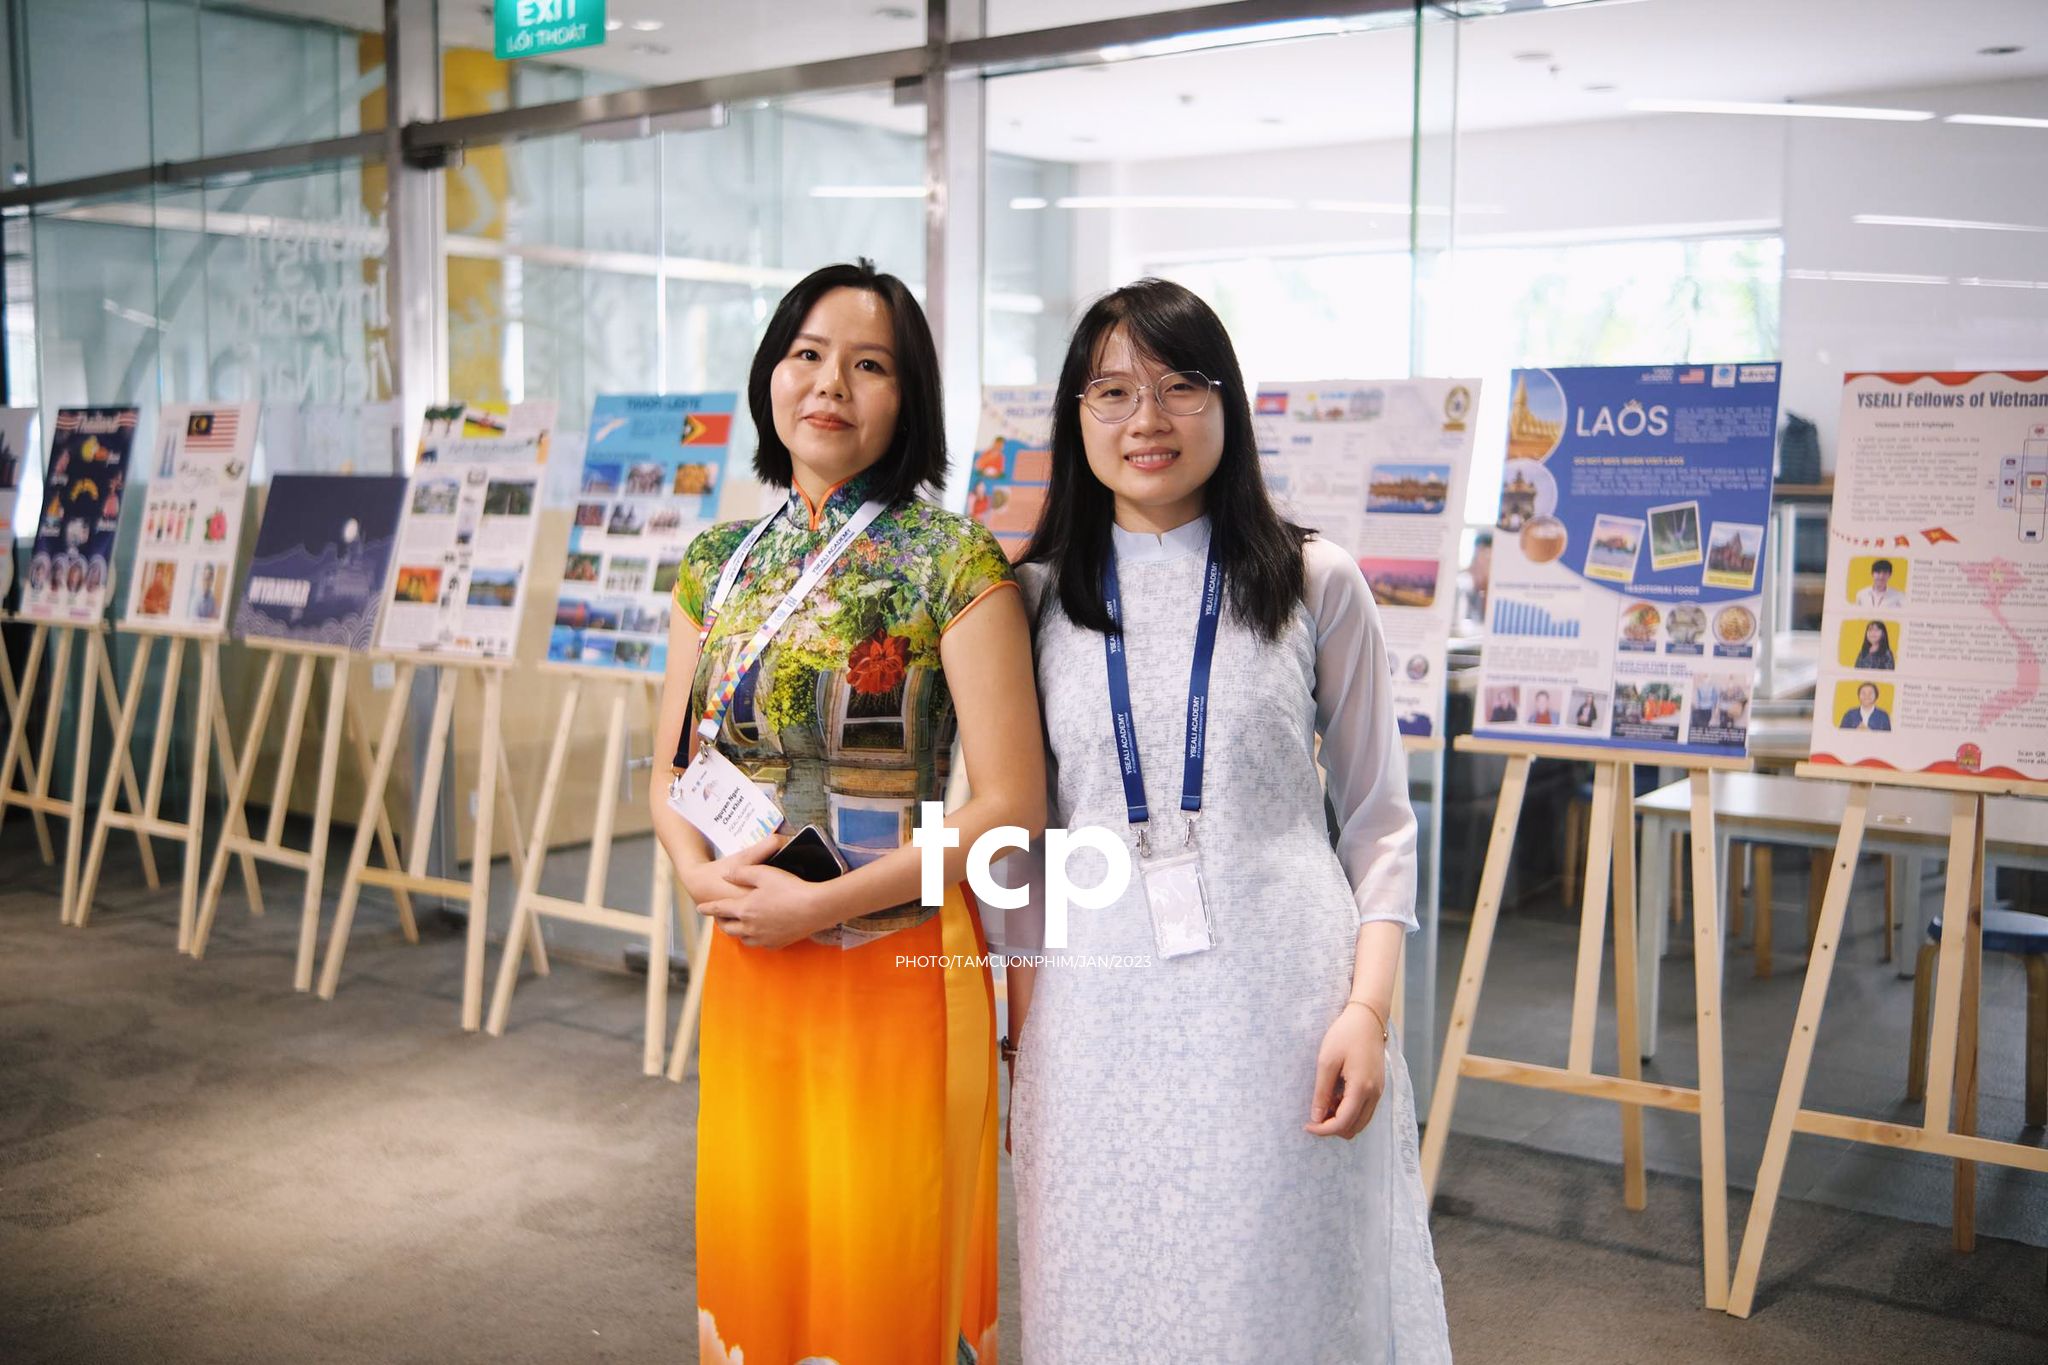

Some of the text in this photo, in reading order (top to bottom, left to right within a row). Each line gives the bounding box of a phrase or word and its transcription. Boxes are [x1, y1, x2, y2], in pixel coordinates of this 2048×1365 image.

[517, 0, 577, 27] EXIT
[1857, 392, 1902, 409] YSEALI
[1906, 391, 1965, 408] Fellows
[1969, 391, 1985, 408] of
[1209, 561, 1218, 593] ACADEMY
[1205, 593, 1214, 616] YSEALI
[1191, 696, 1200, 733] ACADEMY
[1116, 713, 1132, 775] YSEALI ACADEMY
[713, 799, 731, 823] Nguyen
